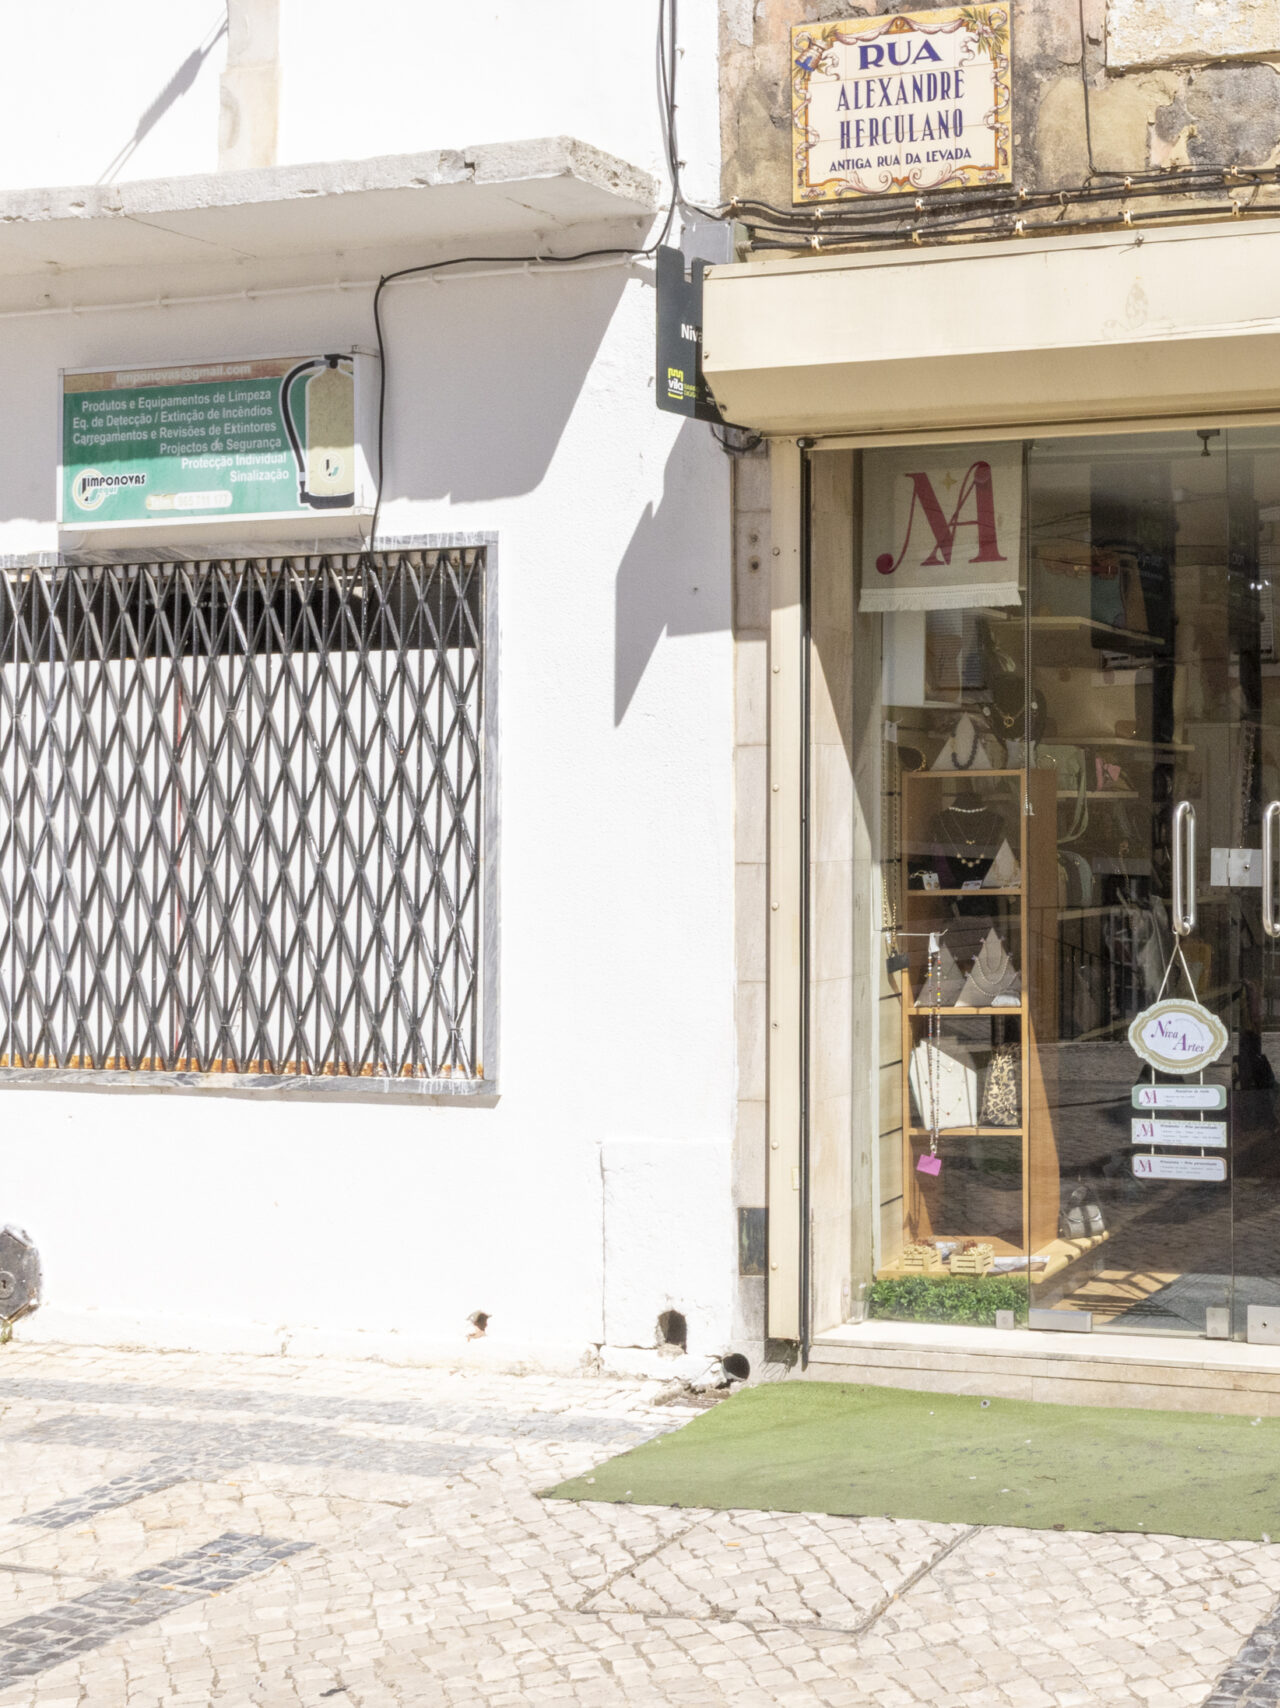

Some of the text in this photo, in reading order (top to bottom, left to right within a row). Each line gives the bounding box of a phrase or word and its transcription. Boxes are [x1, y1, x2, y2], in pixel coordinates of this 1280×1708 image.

[858, 39, 943, 70] RUA
[836, 69, 965, 112] ALEXANDRE
[839, 108, 963, 150] HERCULANO
[829, 147, 972, 172] ANTIGA RUA DA LEVADA
[82, 389, 272, 412] Produtos e Equipamentos de Limpeza
[73, 406, 273, 430] Eq. de Detecção / Extinção de Incêndios
[73, 421, 277, 446] Carregamentos e Revisões de Extintores
[160, 437, 282, 456] Projectos de Segurança
[181, 452, 287, 470] Protecção Individual
[229, 468, 290, 483] Sinalização
[1150, 1019, 1178, 1039] Niva
[1172, 1033, 1204, 1053] Artes
